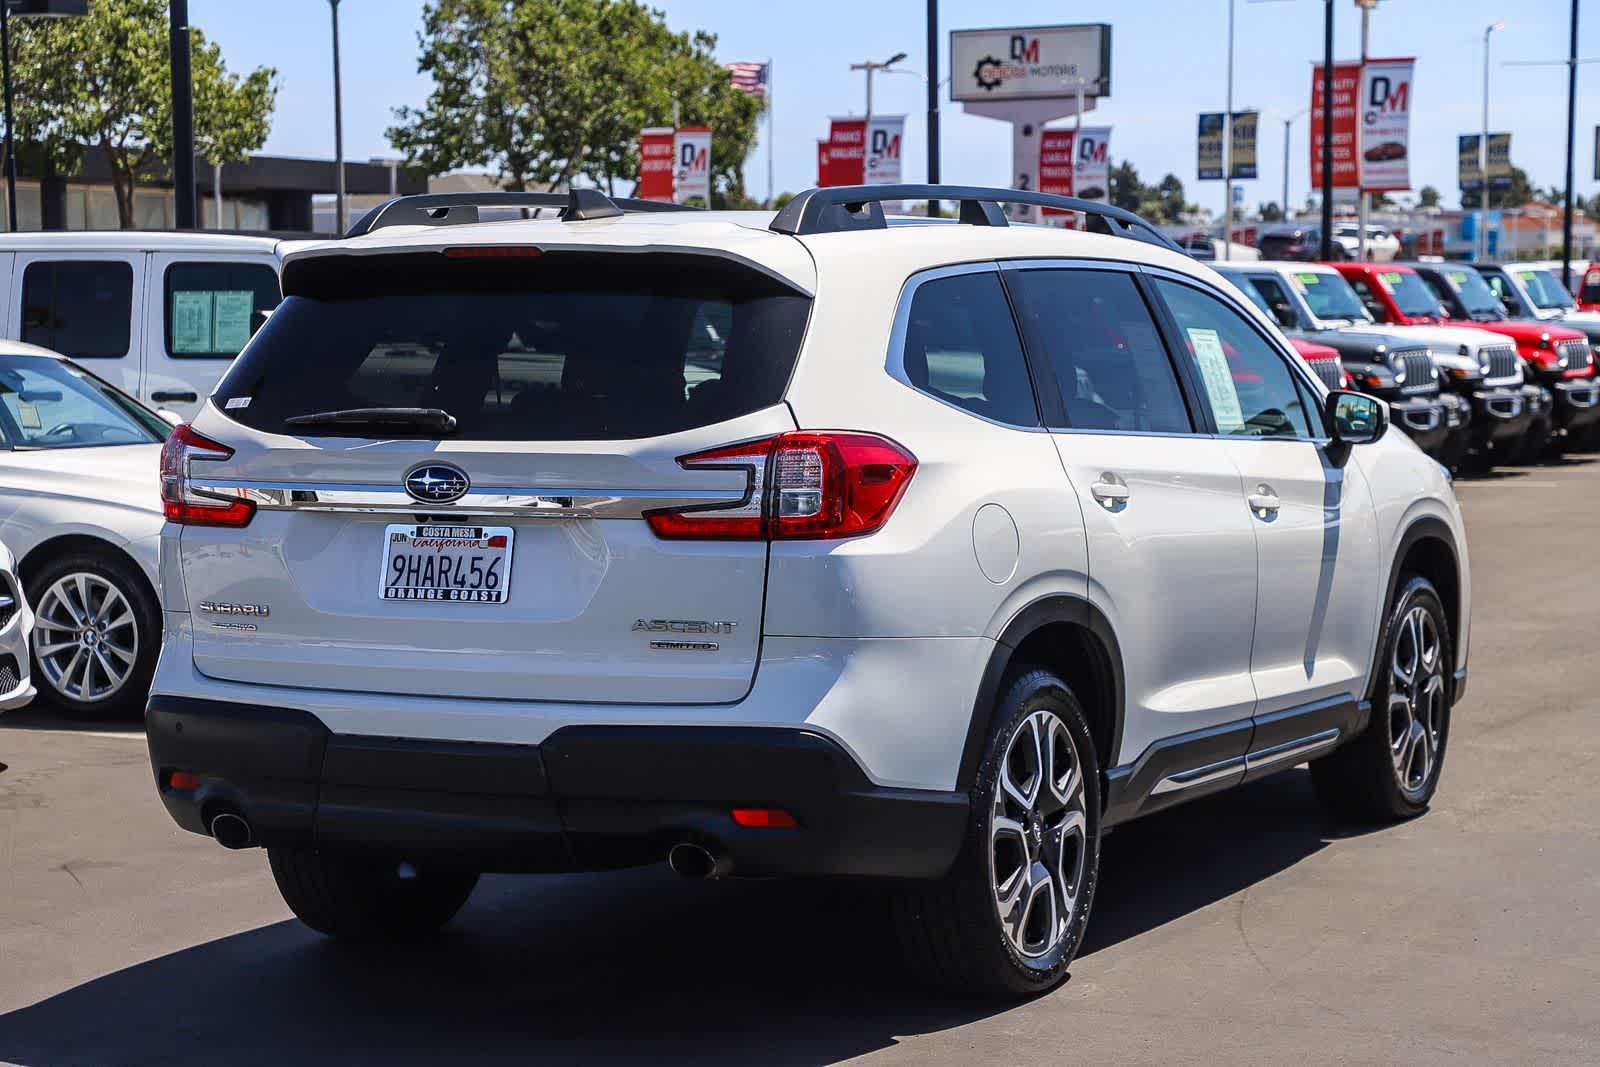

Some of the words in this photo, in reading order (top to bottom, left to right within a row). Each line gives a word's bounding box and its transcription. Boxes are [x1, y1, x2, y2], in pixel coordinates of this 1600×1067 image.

[1315, 78, 1355, 90] QLITY
[1370, 76, 1409, 112] DM
[422, 527, 450, 537] COSTA
[452, 528, 476, 538] MESA
[390, 554, 501, 589] 9HAR456
[387, 587, 444, 599] ORANGE
[450, 590, 499, 601] COAST
[199, 601, 270, 617] SUBARU
[631, 618, 738, 634] ASCENT
